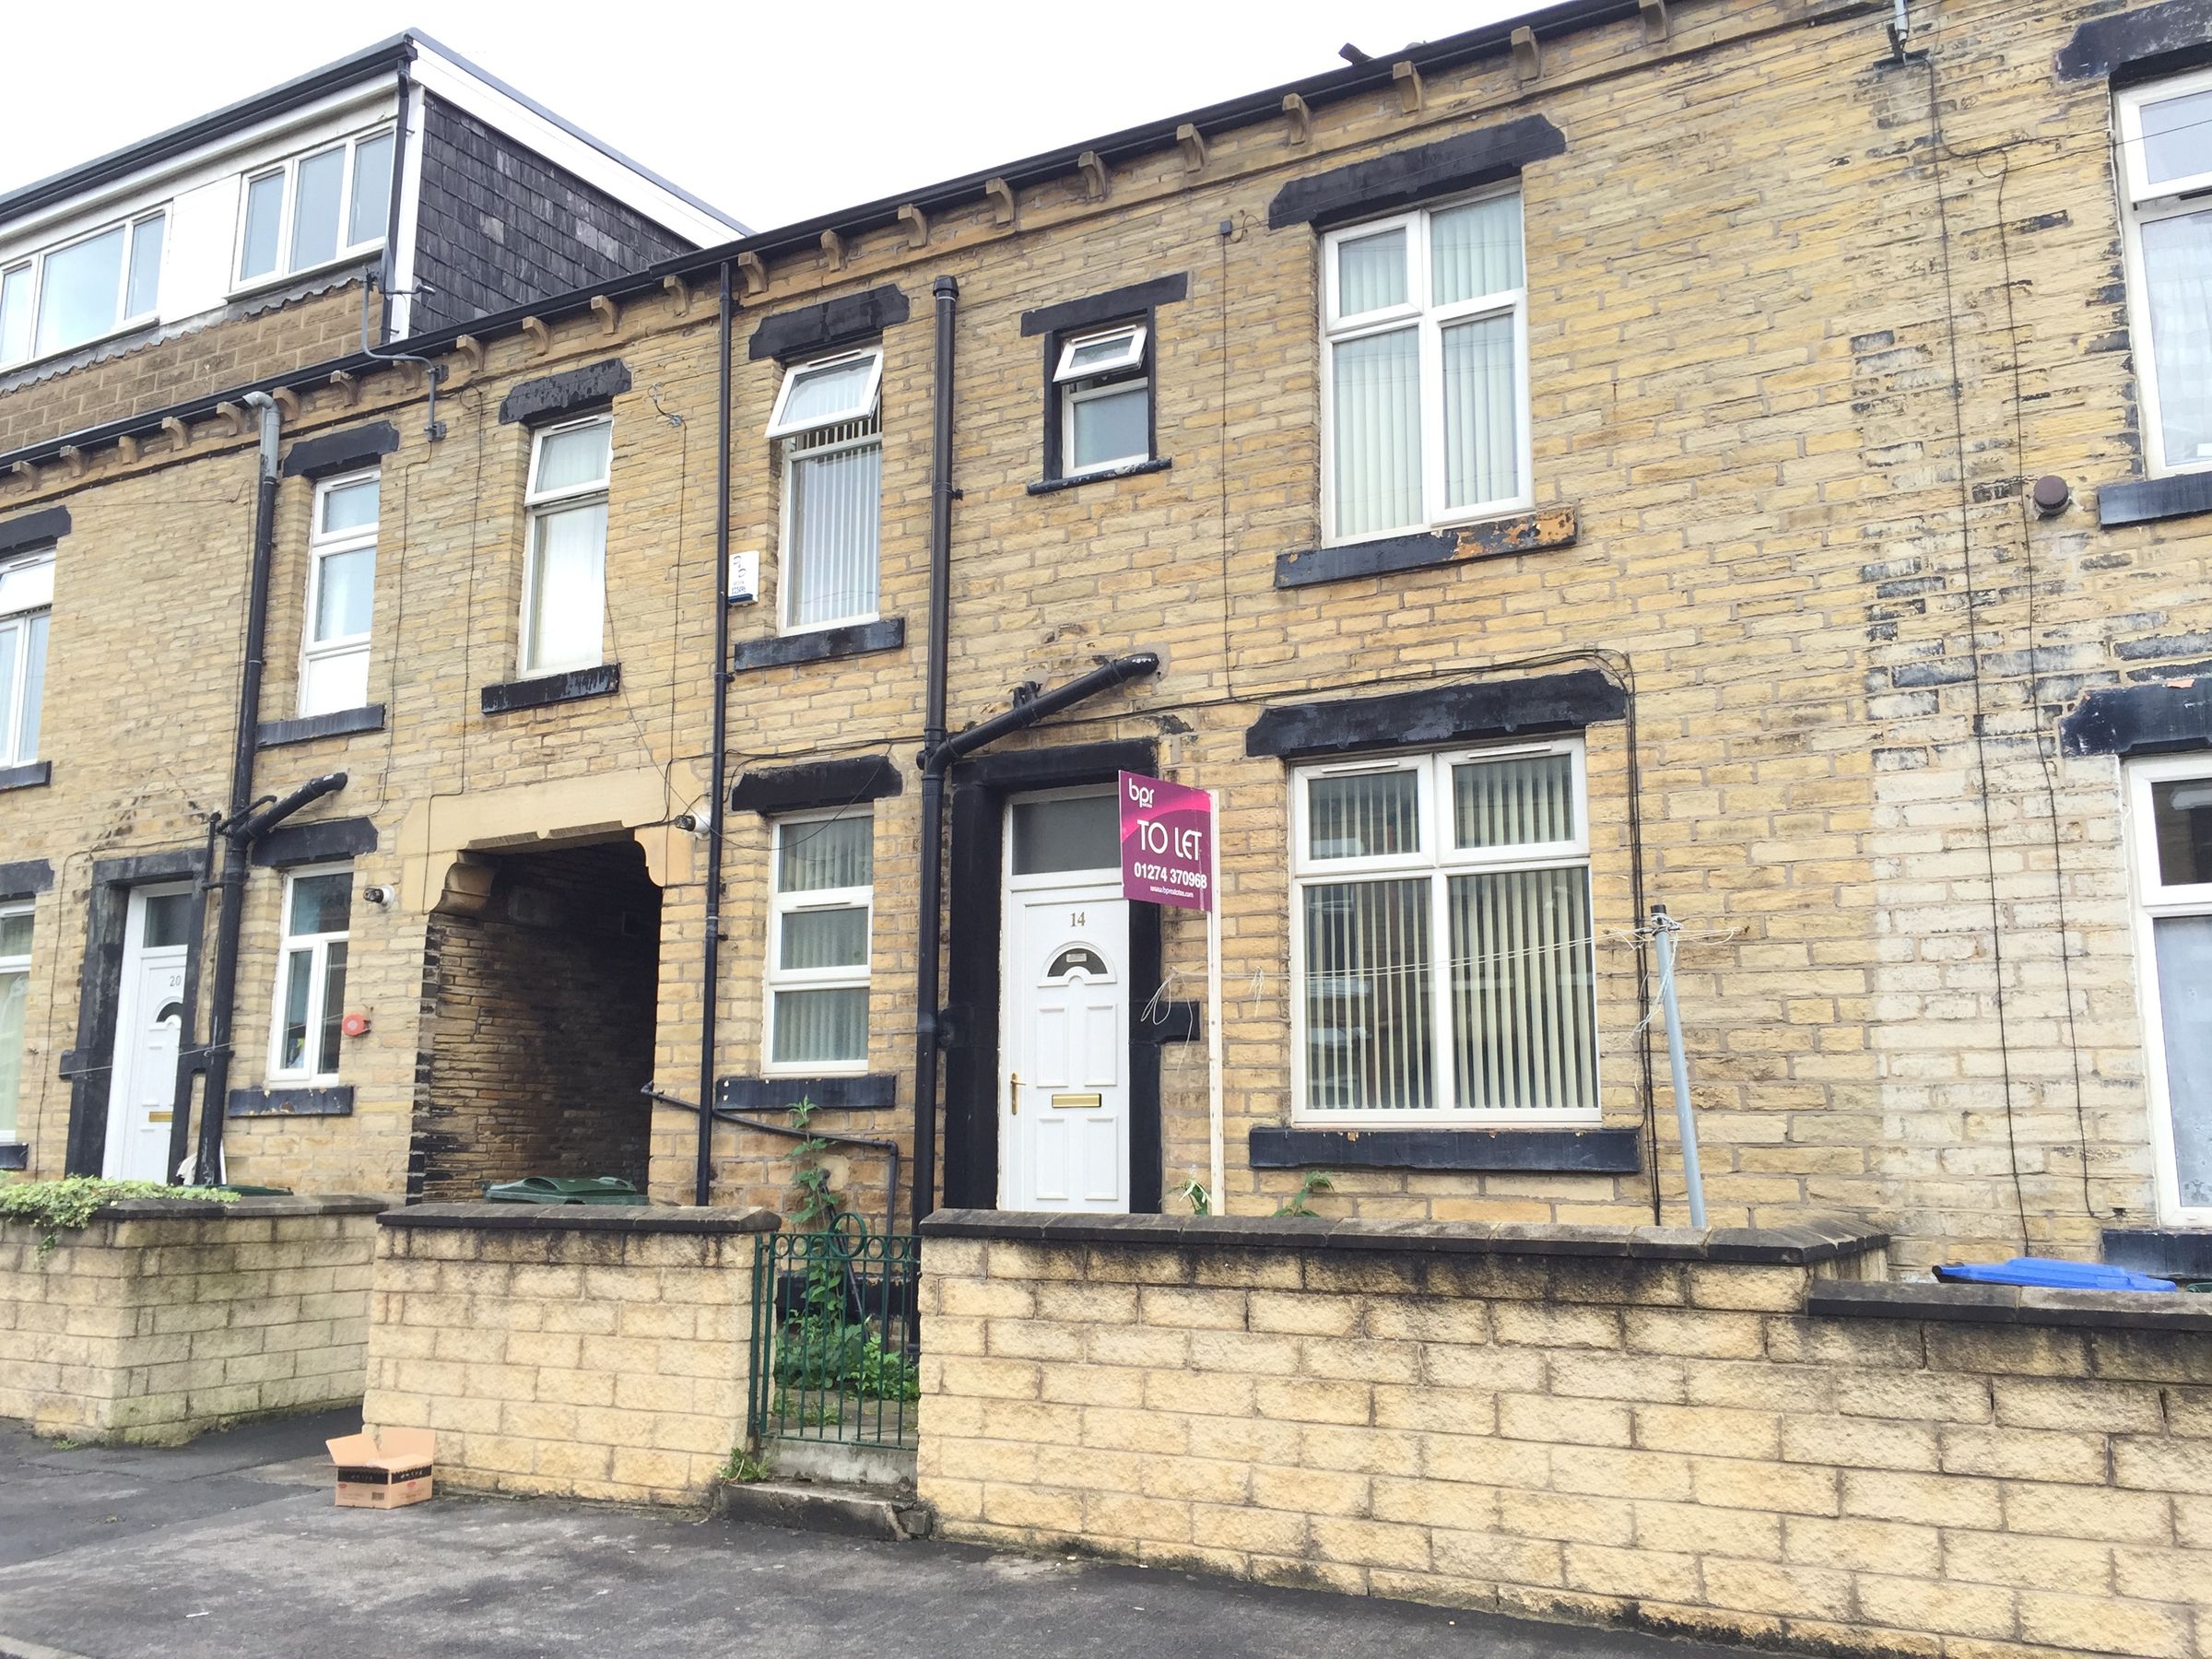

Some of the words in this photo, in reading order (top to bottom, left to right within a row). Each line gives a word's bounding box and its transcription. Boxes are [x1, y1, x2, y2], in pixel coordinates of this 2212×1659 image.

[1129, 778, 1155, 808] bpr
[1136, 819, 1169, 854] TO
[1174, 827, 1203, 861] LET
[1134, 862, 1168, 882] 01274
[1170, 869, 1207, 889] 370968
[1070, 912, 1086, 927] 14
[170, 974, 182, 987] 20
